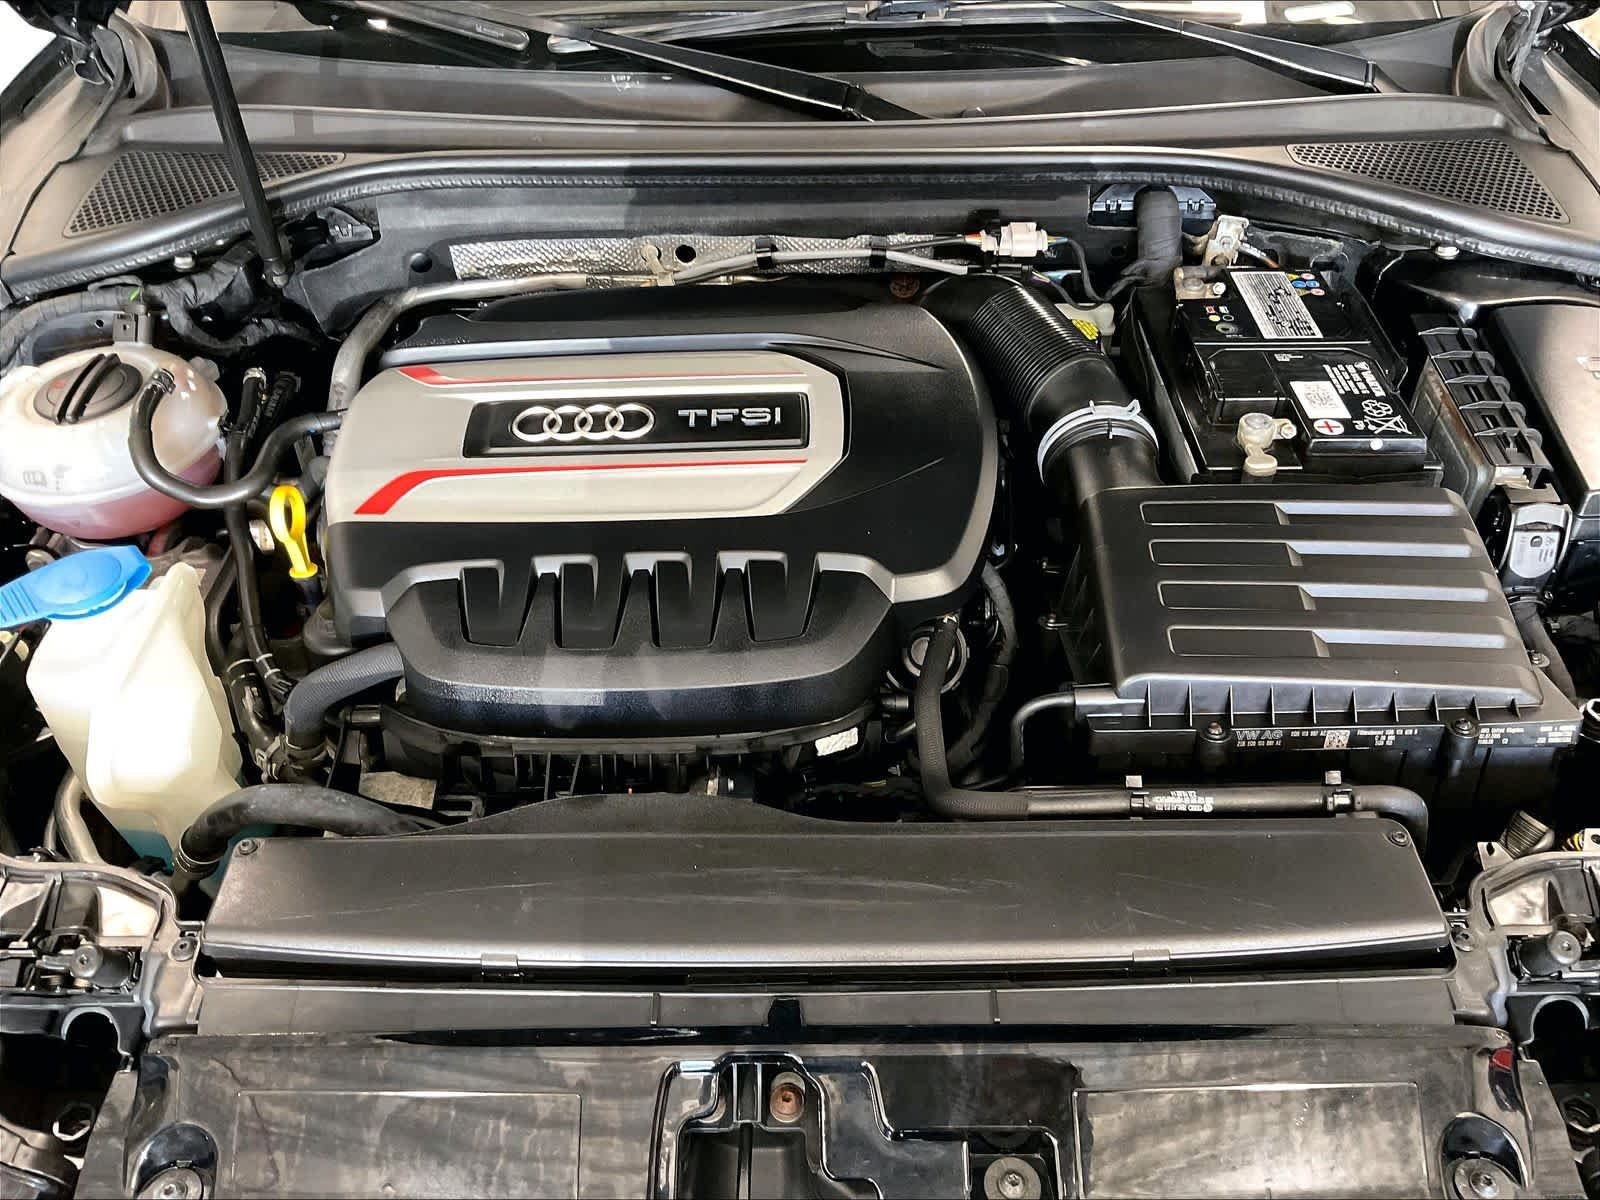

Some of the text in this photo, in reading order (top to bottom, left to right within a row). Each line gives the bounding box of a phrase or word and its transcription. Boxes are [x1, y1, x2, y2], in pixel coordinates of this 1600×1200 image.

[677, 406, 782, 428] TFSI
[1236, 730, 1260, 740] VW
[1261, 729, 1283, 740] AG
